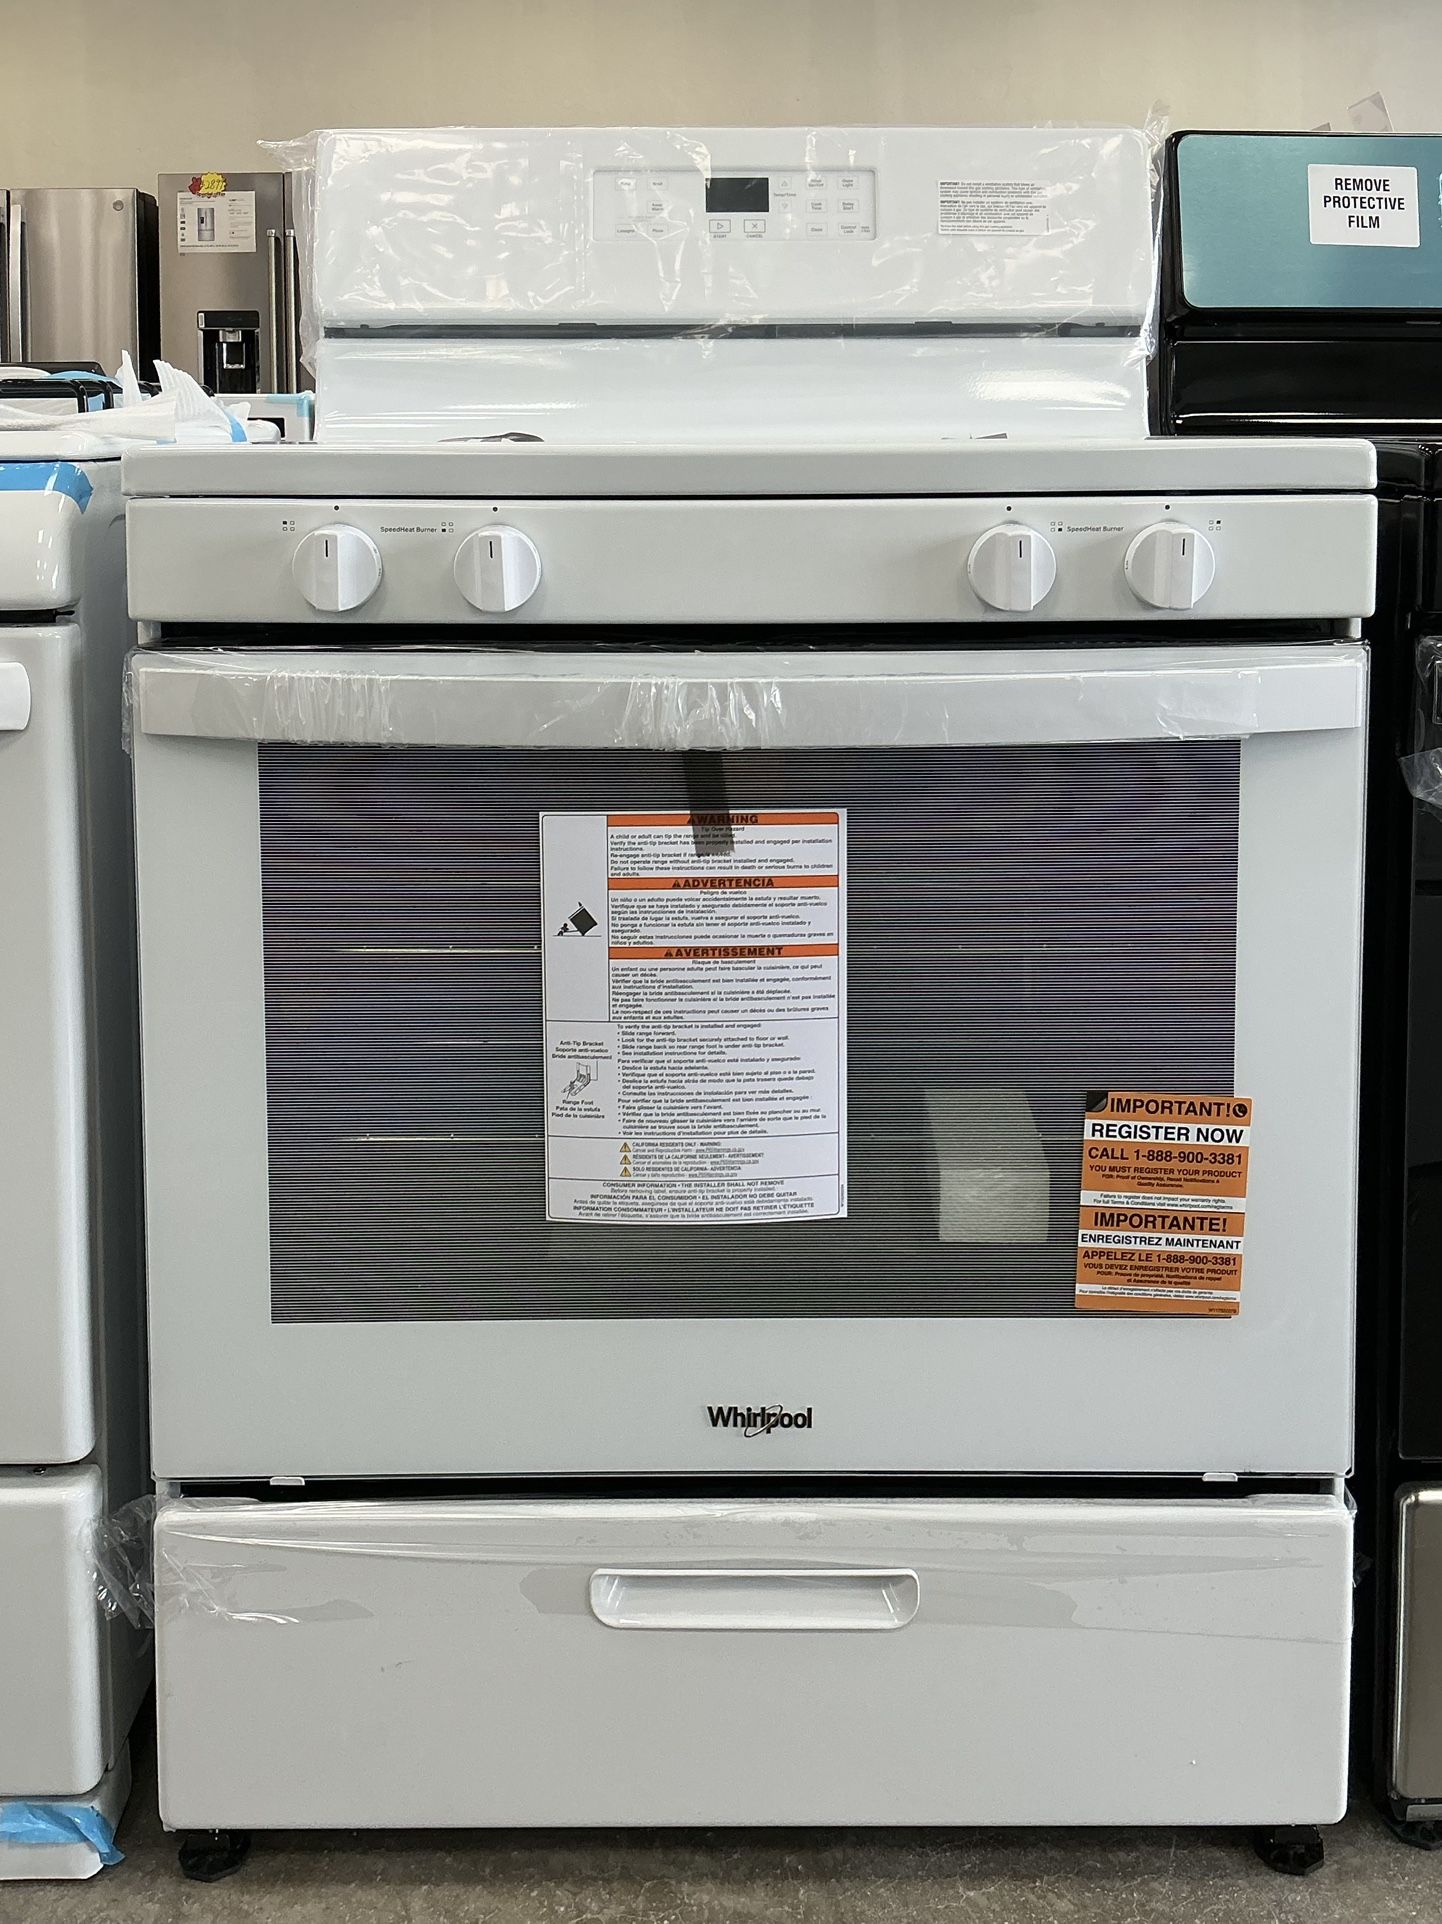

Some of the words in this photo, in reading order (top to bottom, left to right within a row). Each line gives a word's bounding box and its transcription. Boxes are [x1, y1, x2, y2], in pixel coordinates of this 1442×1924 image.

[1334, 178, 1390, 192] REMOVE
[1323, 195, 1406, 210] PROTECTIVE
[1348, 215, 1380, 229] FILM
[1066, 525, 1102, 533] SpeedHeat
[683, 878, 774, 888] ADVERTENCIA
[675, 947, 783, 957] AVERTISSEMENT
[1110, 1098, 1230, 1118] IMPORTANT!
[1092, 1123, 1190, 1142] REGISTER
[1196, 1127, 1244, 1144] NOW
[1088, 1147, 1129, 1161] CALL
[1133, 1148, 1242, 1166] 1-888-900-3381
[1133, 1167, 1174, 1175] REGISTER
[1201, 1170, 1242, 1178] PRODUCT
[1094, 1211, 1227, 1233] IMPORTANTE!
[1081, 1233, 1163, 1247] ENREGISTREZ
[1165, 1237, 1241, 1250] MAINTENANT
[1083, 1250, 1136, 1263] APPELEZ
[1138, 1252, 1153, 1263] LE
[1156, 1253, 1236, 1267] 1-888-900-3381
[1084, 1263, 1103, 1271] VOUS
[1104, 1264, 1128, 1272] DEVEZ
[1129, 1265, 1179, 1274] ENREGISTRER
[1180, 1267, 1204, 1275] VOTRE
[1206, 1268, 1237, 1276] PRODUIT
[706, 1405, 813, 1438] Whirlpool
